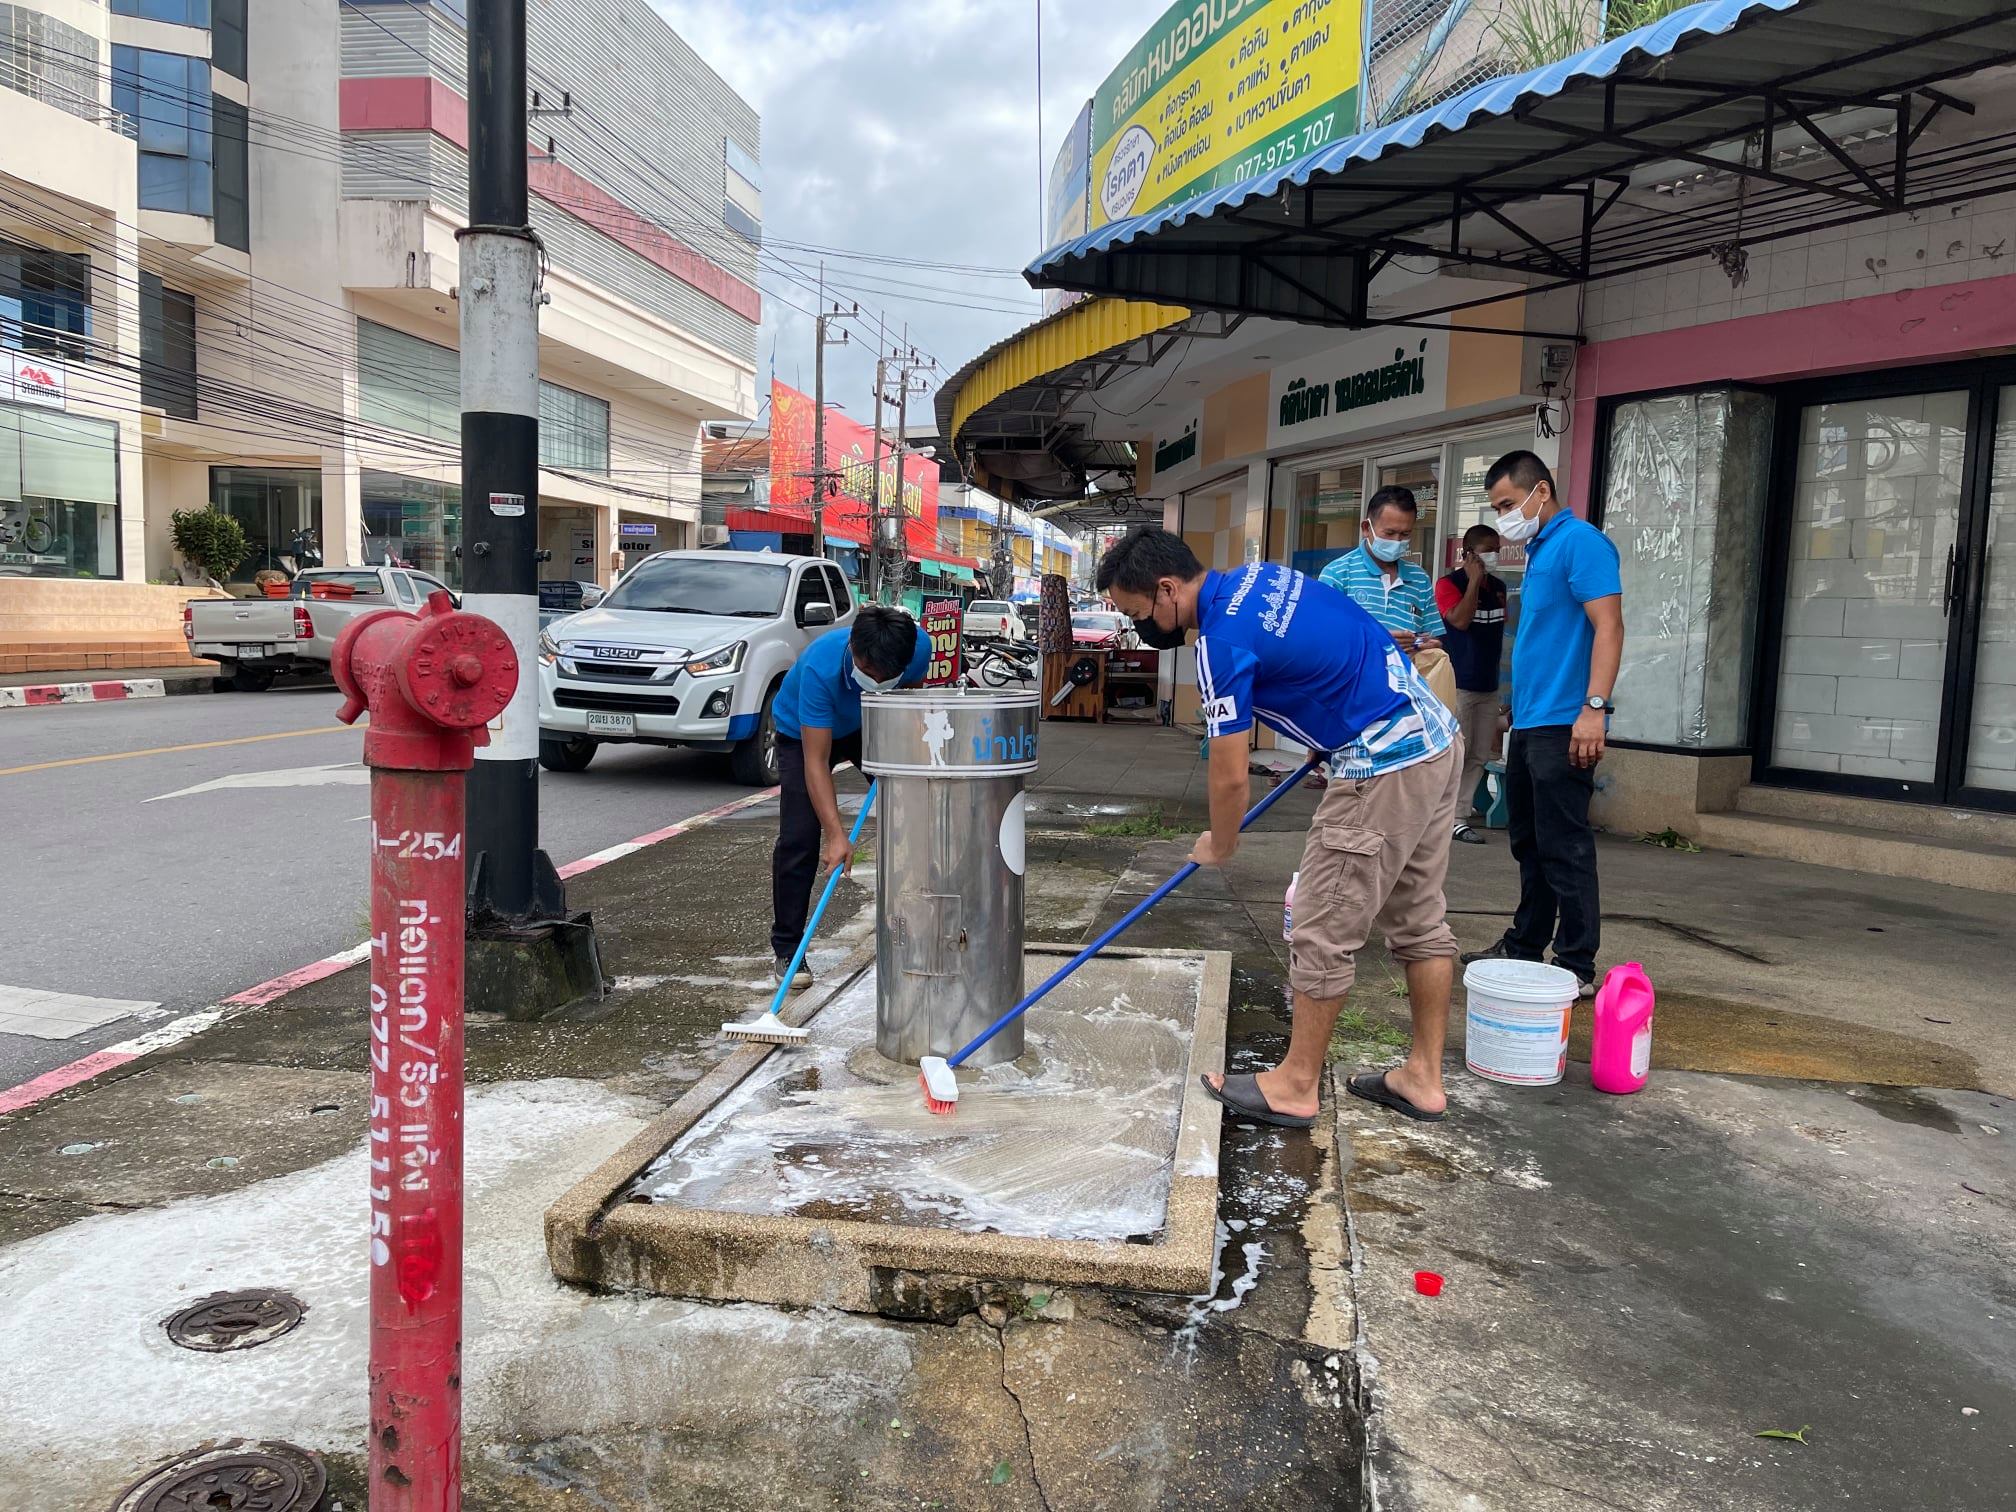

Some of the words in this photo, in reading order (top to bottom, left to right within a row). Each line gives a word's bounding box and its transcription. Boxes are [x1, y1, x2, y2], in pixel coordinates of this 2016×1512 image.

[1290, 24, 1330, 64] ตาแดง
[1237, 58, 1270, 97] ตาแห้ง
[1165, 79, 1201, 119] ต้อกระจก
[1235, 67, 1311, 132] เบาหวานขึ้นตา
[1234, 134, 1296, 184] 077-975
[1302, 112, 1335, 153] 707
[1106, 151, 1145, 202] โรคตา
[21, 381, 61, 400] Stallions
[926, 614, 956, 632] รับทำ
[596, 648, 638, 659] ISUZU
